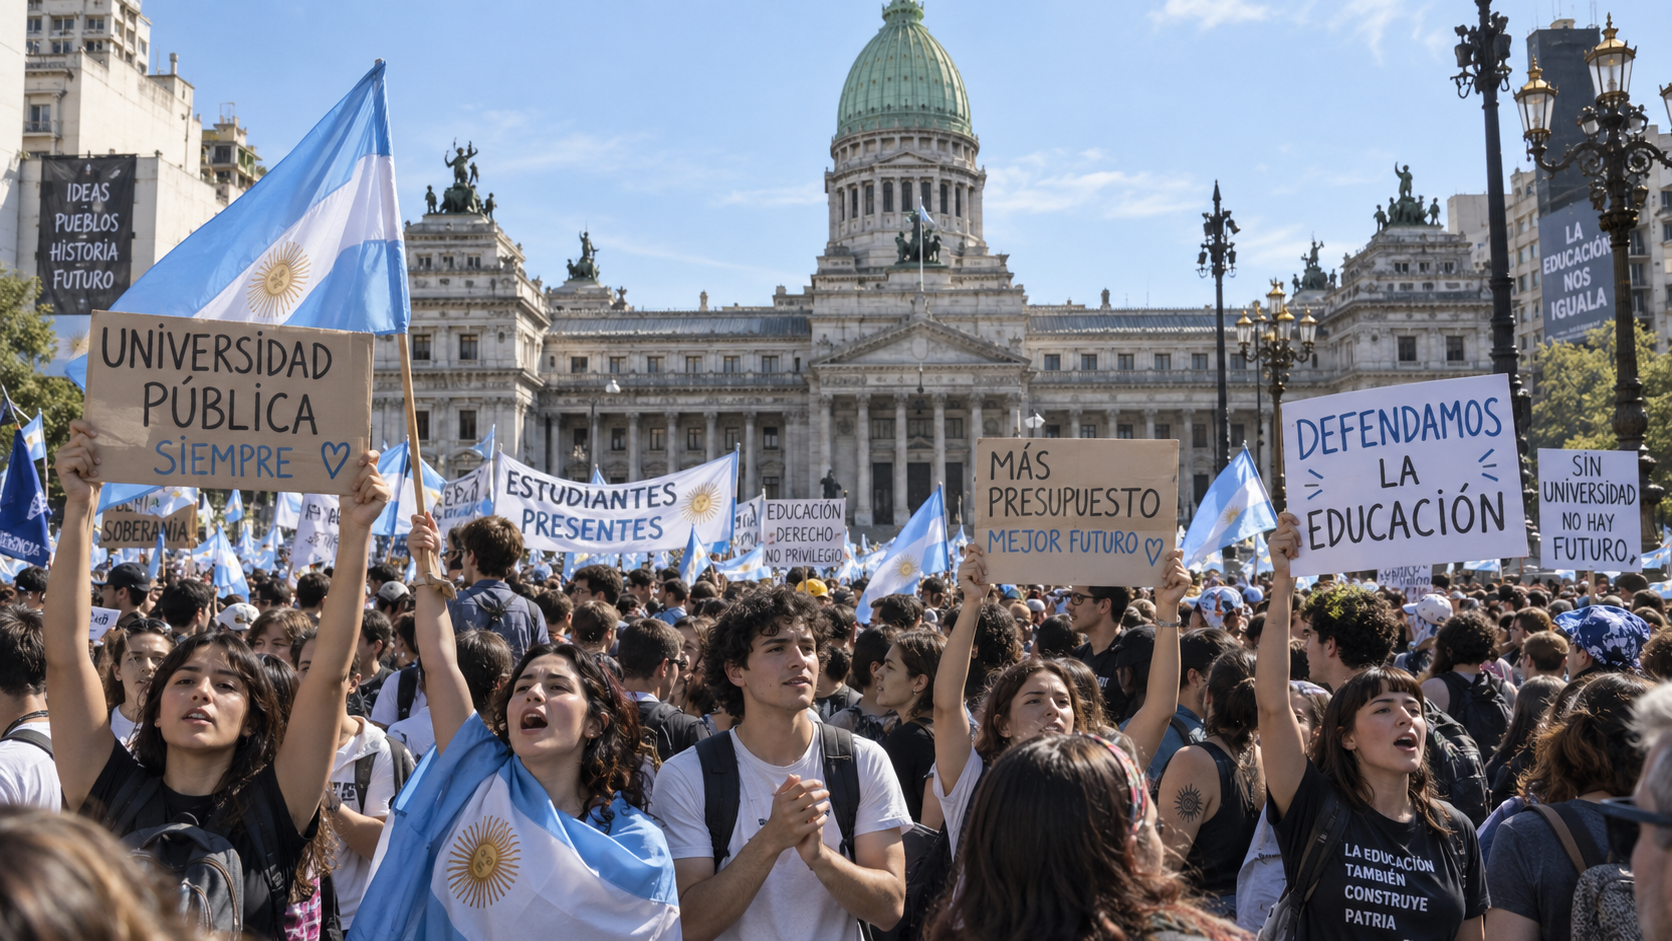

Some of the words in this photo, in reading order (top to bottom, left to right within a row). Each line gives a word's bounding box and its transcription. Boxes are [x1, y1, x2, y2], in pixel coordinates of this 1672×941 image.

[66, 182, 110, 203] IDEAS
[55, 212, 119, 234] PUEBLOS
[1565, 221, 1584, 246] LA
[49, 237, 119, 262] HISTORIA
[1543, 234, 1612, 275] EDUCACIÓN
[53, 268, 115, 290] FUTURO
[1563, 266, 1592, 293] NOS
[1550, 286, 1608, 321] IGUALA
[102, 322, 333, 380] UNIVERSIDAD
[143, 375, 319, 436] PÚBLICA
[1296, 396, 1502, 461] DEFENDAMOS
[153, 435, 294, 479] SIEMPRE
[990, 442, 1051, 481] MÁS
[1572, 452, 1602, 477] SIN
[1379, 454, 1420, 489] LA
[506, 469, 678, 510] ESTUDIANTES
[989, 486, 1161, 519] PRESUPUESTO
[1543, 478, 1637, 506] UNIVERSIDAD
[767, 500, 842, 520] EDUCACIÓN
[1306, 482, 1506, 551] EDUCACIÓN
[1562, 511, 1582, 531] NO
[1587, 512, 1615, 533] HAY
[521, 508, 664, 542] PRESENTES
[776, 526, 834, 543] DERECHO
[765, 548, 781, 564] NO
[785, 546, 843, 564] PRIVILEGIO
[988, 529, 1062, 554] MEJOR
[1069, 529, 1139, 555] FUTURO
[1344, 843, 1362, 858] LA
[1363, 847, 1435, 873] EDUCACIÓN
[1344, 863, 1406, 887] TAMBIÉN
[1344, 884, 1429, 912] CONSTRUYE
[1344, 908, 1397, 931] PATRIA
